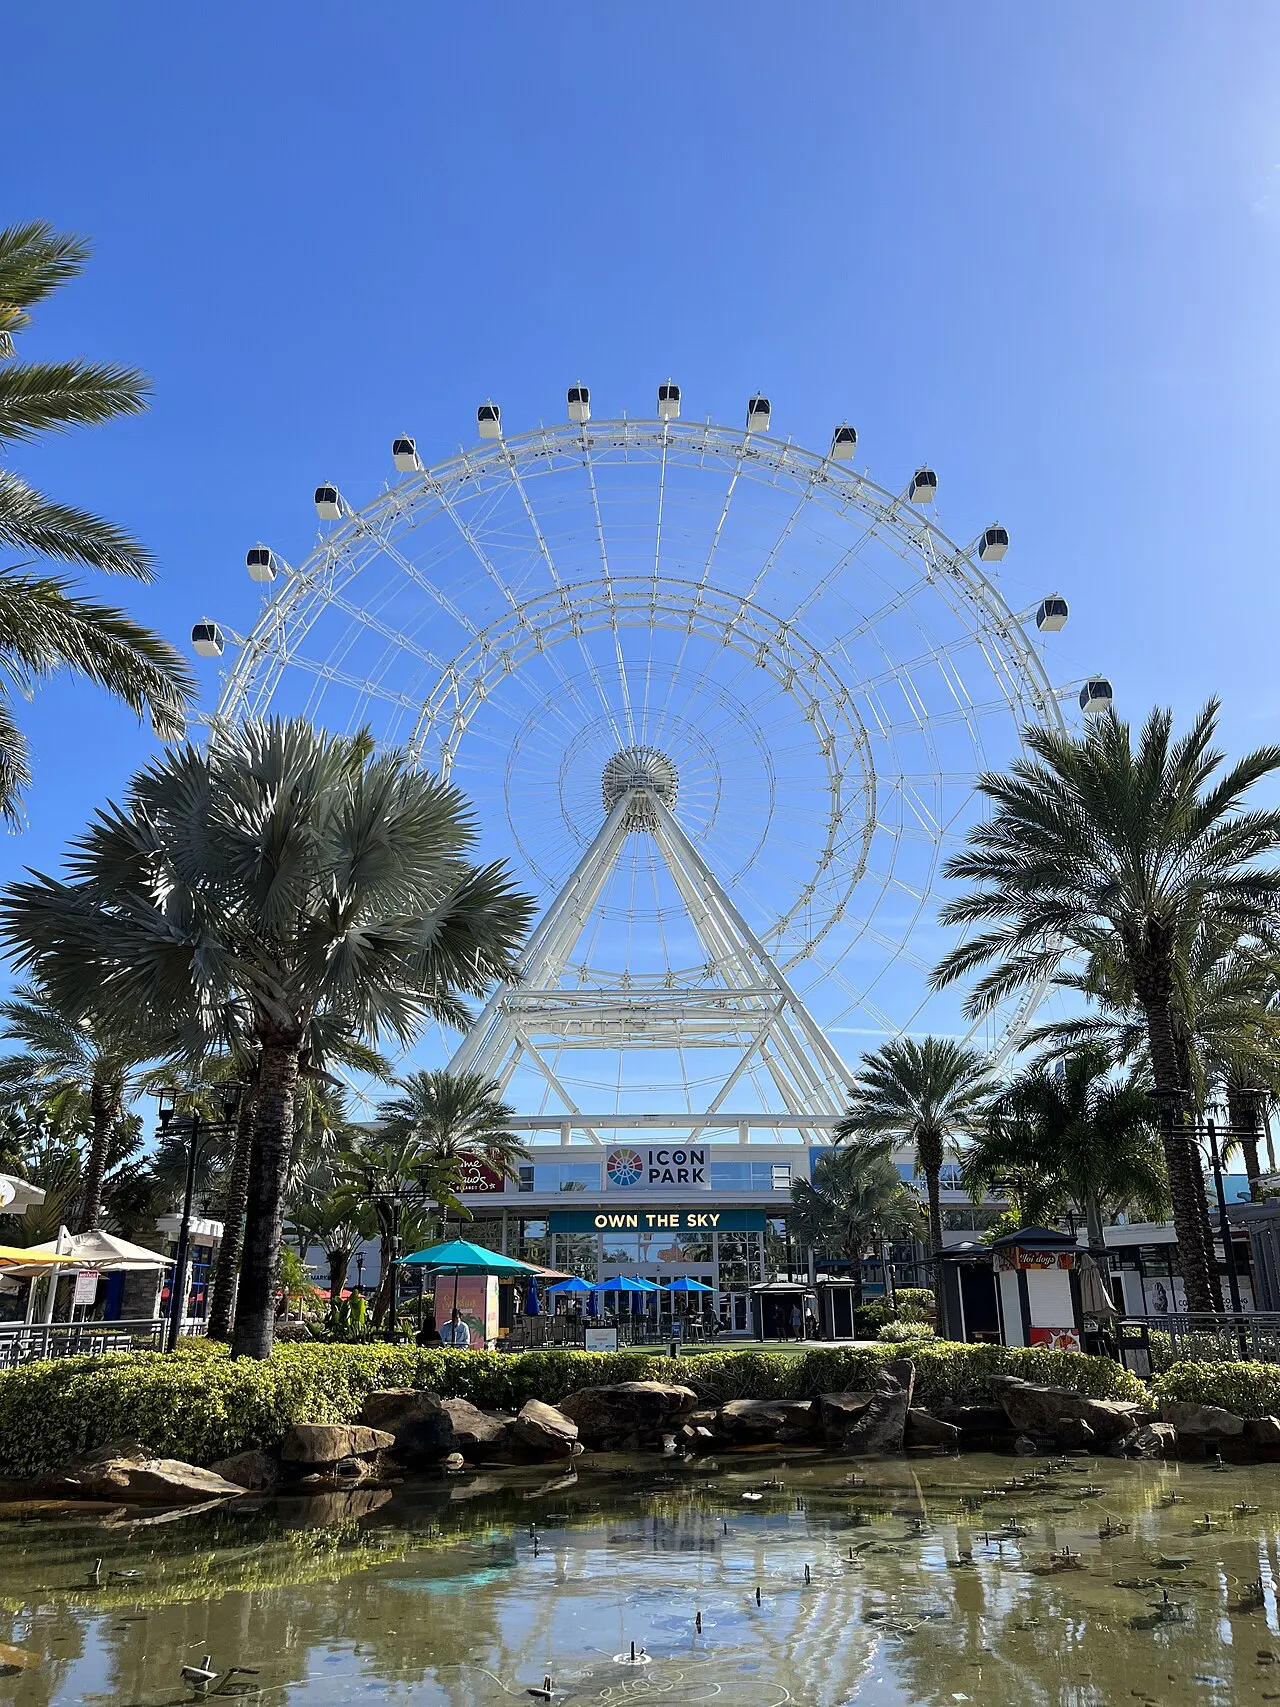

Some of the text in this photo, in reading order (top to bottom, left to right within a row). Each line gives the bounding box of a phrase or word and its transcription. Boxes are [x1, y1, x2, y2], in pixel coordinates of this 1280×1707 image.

[648, 1150, 705, 1166] ICON
[648, 1168, 705, 1183] PARK
[594, 1213, 720, 1228] OWN THE SKY
[1035, 1253, 1055, 1266] dogs
